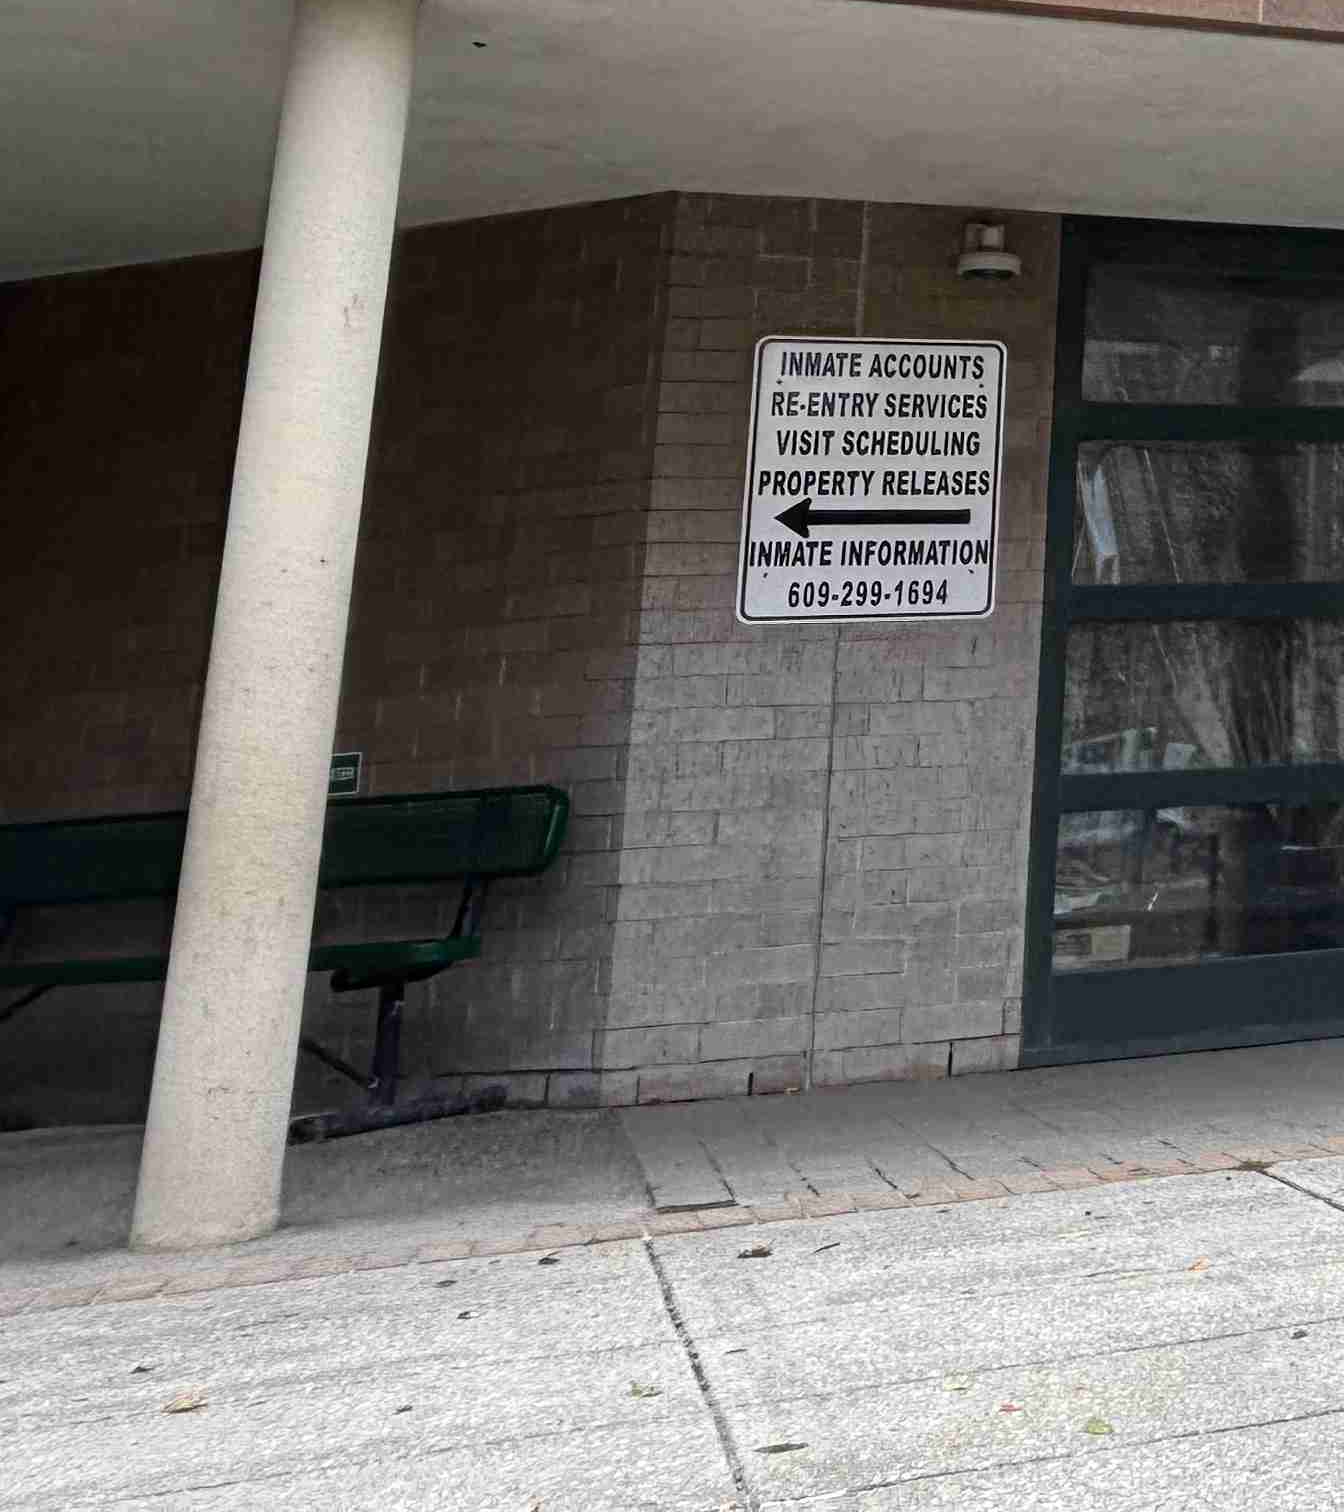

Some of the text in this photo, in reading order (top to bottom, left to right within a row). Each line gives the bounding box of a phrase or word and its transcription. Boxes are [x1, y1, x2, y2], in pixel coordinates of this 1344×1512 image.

[780, 351, 985, 380] INMATE ACCOUNTS
[771, 390, 988, 419] RE-ENTRY SERVICES
[776, 430, 981, 456] VISIT SCHEDULING
[757, 470, 990, 496] PROPERTY RELEASES
[750, 539, 989, 567] INMATE INFORMATION
[787, 579, 949, 609] 609-299-1694
